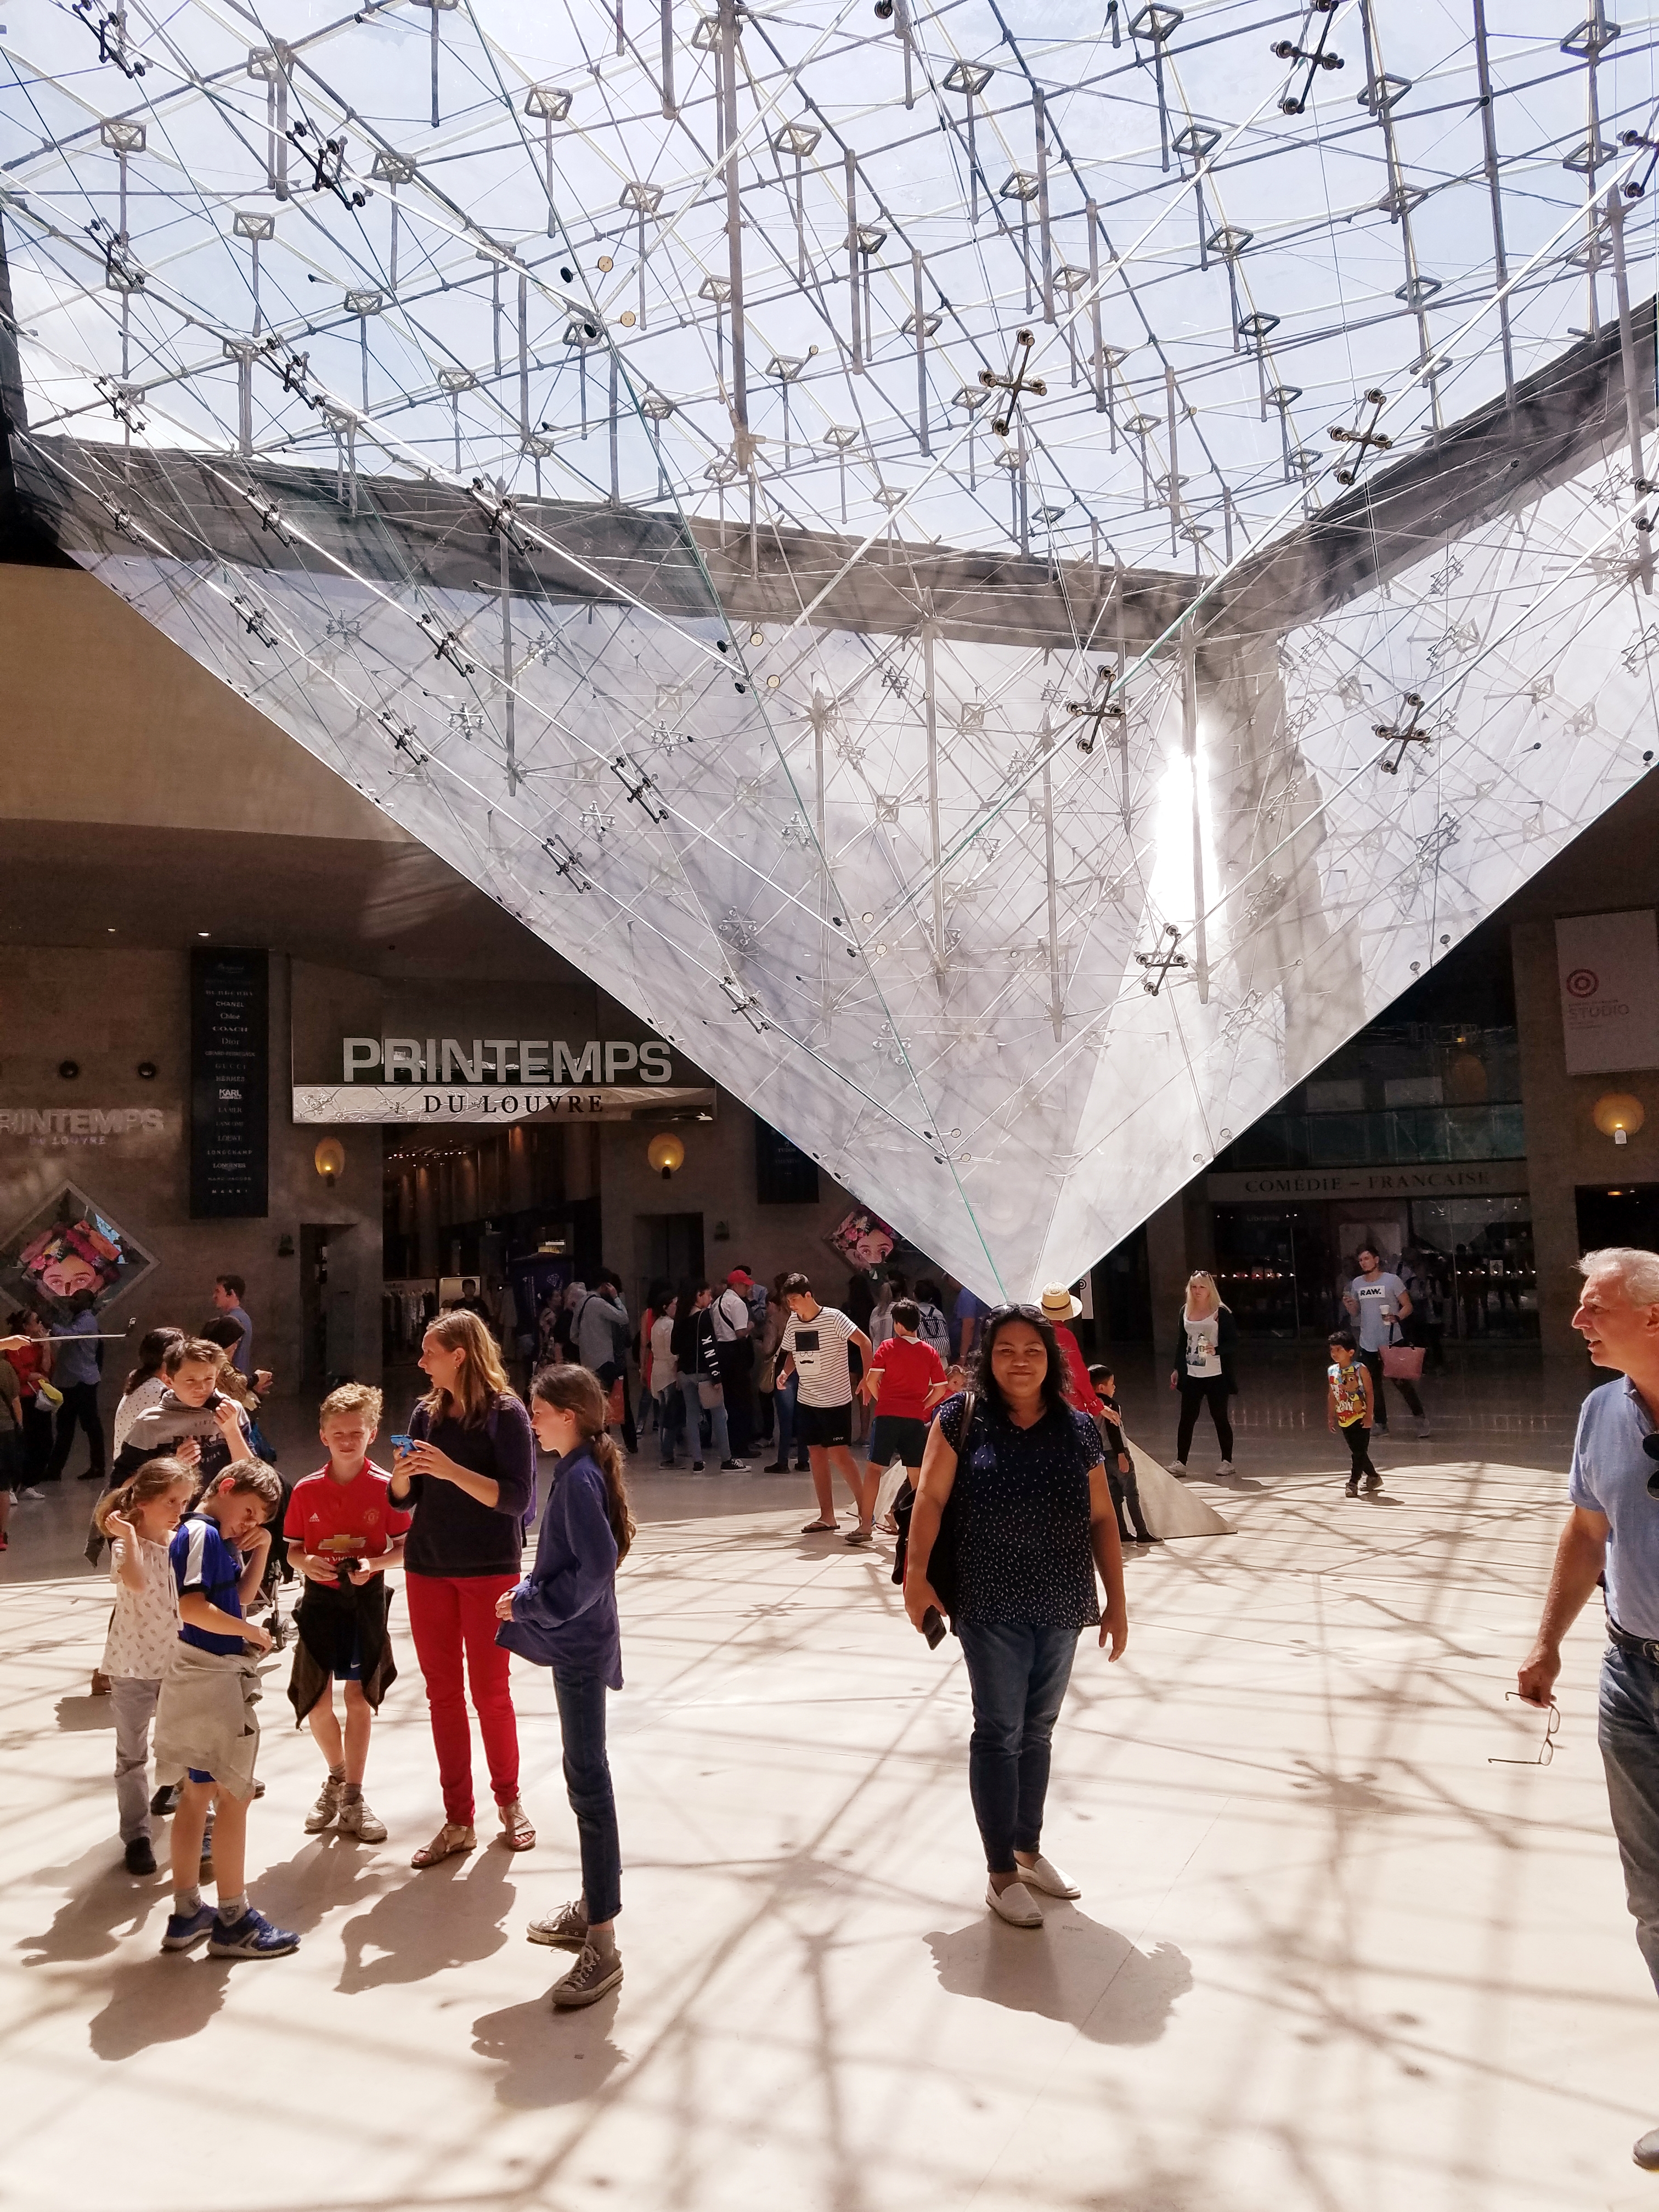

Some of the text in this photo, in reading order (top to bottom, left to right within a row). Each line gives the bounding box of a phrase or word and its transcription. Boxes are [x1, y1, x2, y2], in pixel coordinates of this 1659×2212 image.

[1568, 1003, 1629, 1019] STUDIO
[342, 1037, 673, 1084] PRINTEMPS
[423, 1095, 605, 1114] DU LOUVRE
